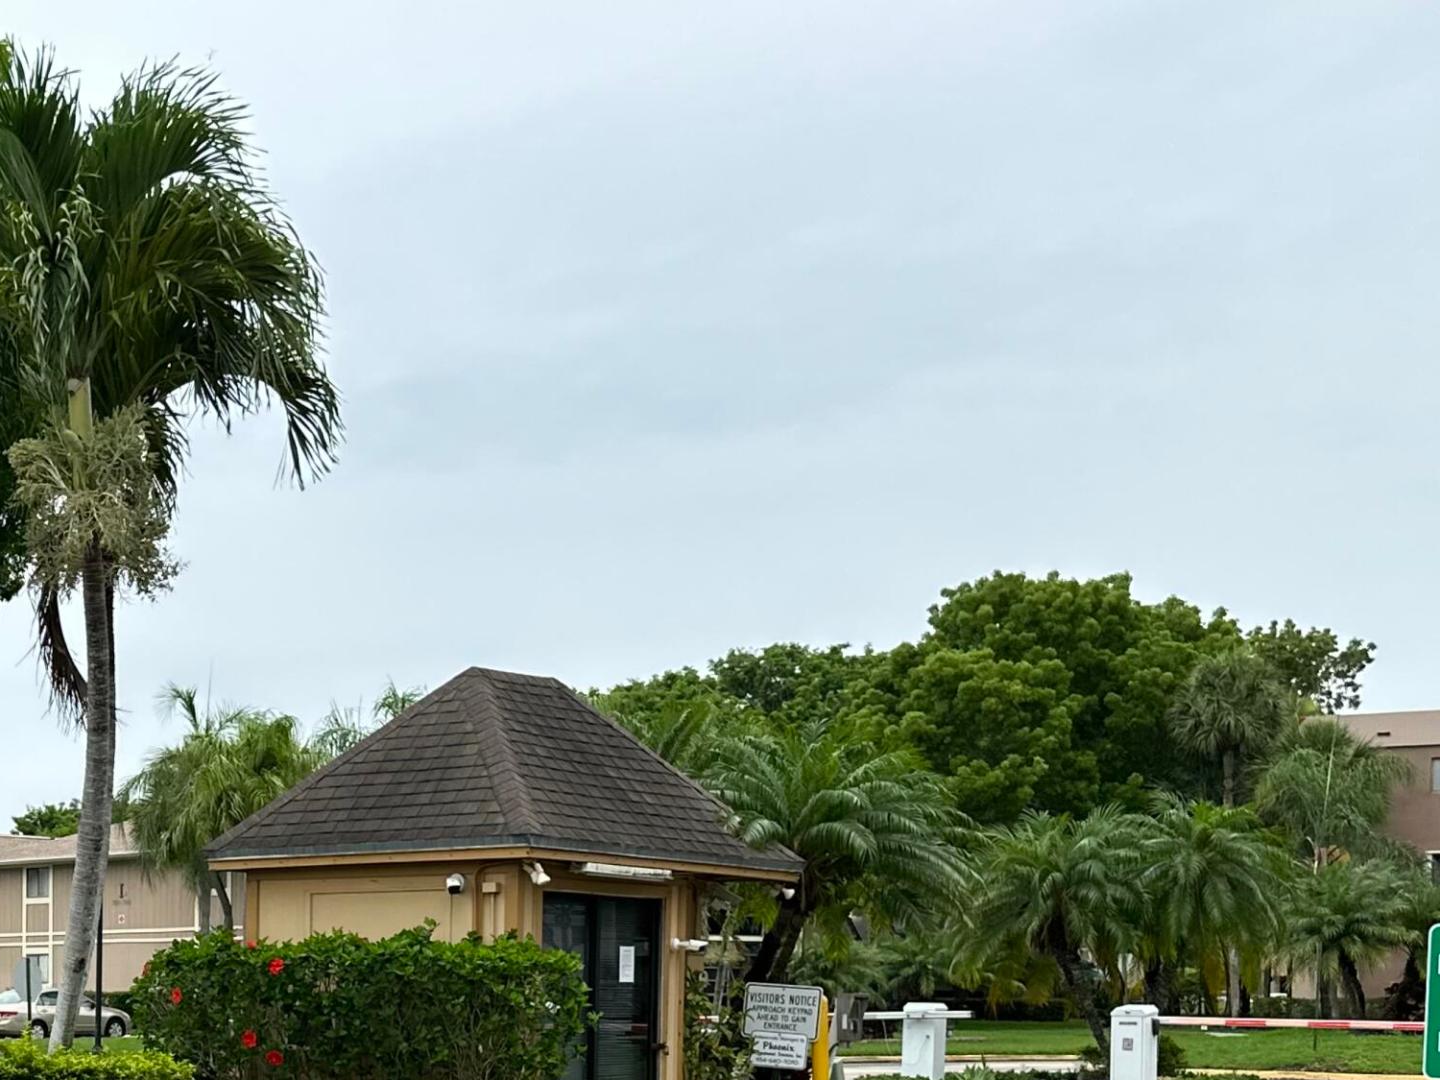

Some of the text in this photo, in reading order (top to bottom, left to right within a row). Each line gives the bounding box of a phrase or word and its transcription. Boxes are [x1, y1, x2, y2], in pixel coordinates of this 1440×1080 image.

[749, 992, 817, 1008] VISITORS NOTICE
[752, 1004, 813, 1016] APPROACH KEYPAD
[757, 1013, 779, 1022] AHEAD
[763, 1022, 798, 1031] ENTRANCE
